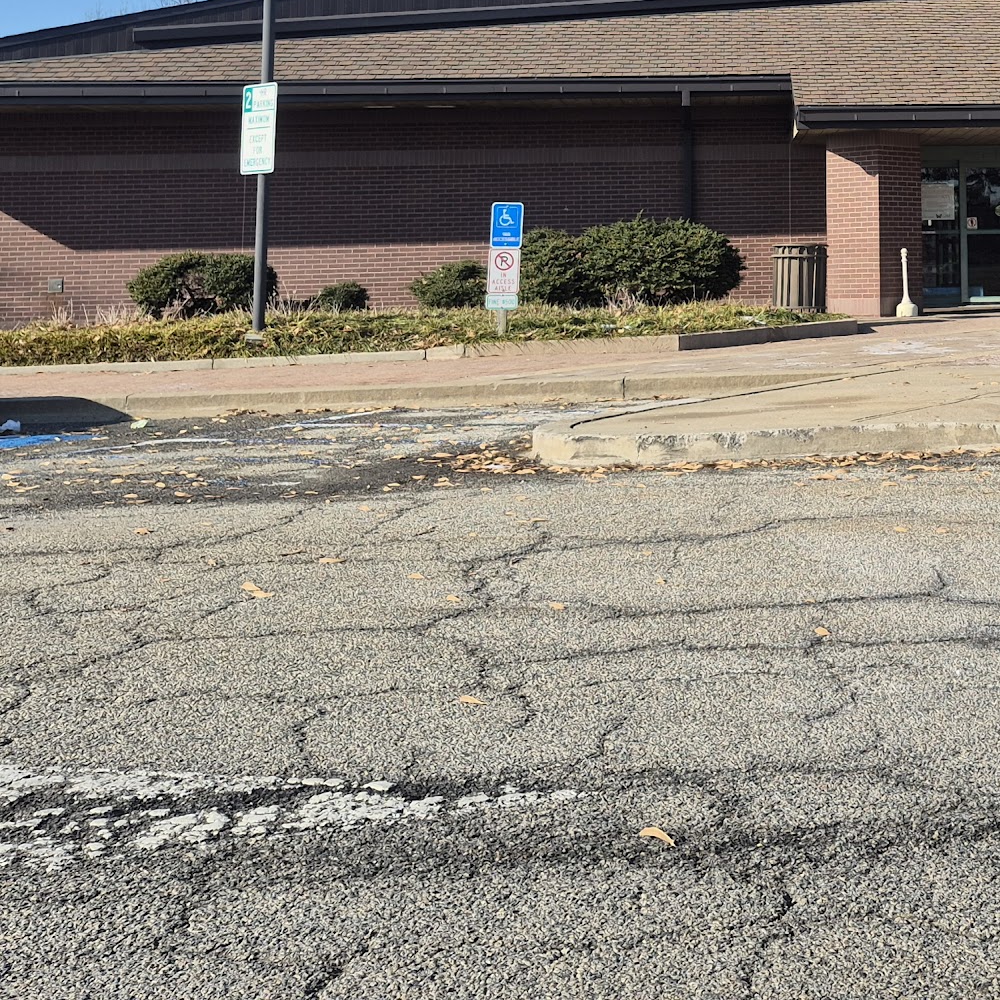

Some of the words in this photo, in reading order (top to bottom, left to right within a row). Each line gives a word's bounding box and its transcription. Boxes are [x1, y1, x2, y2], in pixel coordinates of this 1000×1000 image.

[245, 91, 252, 110] 2
[249, 134, 267, 144] EXCEPT
[253, 146, 263, 155] FOR
